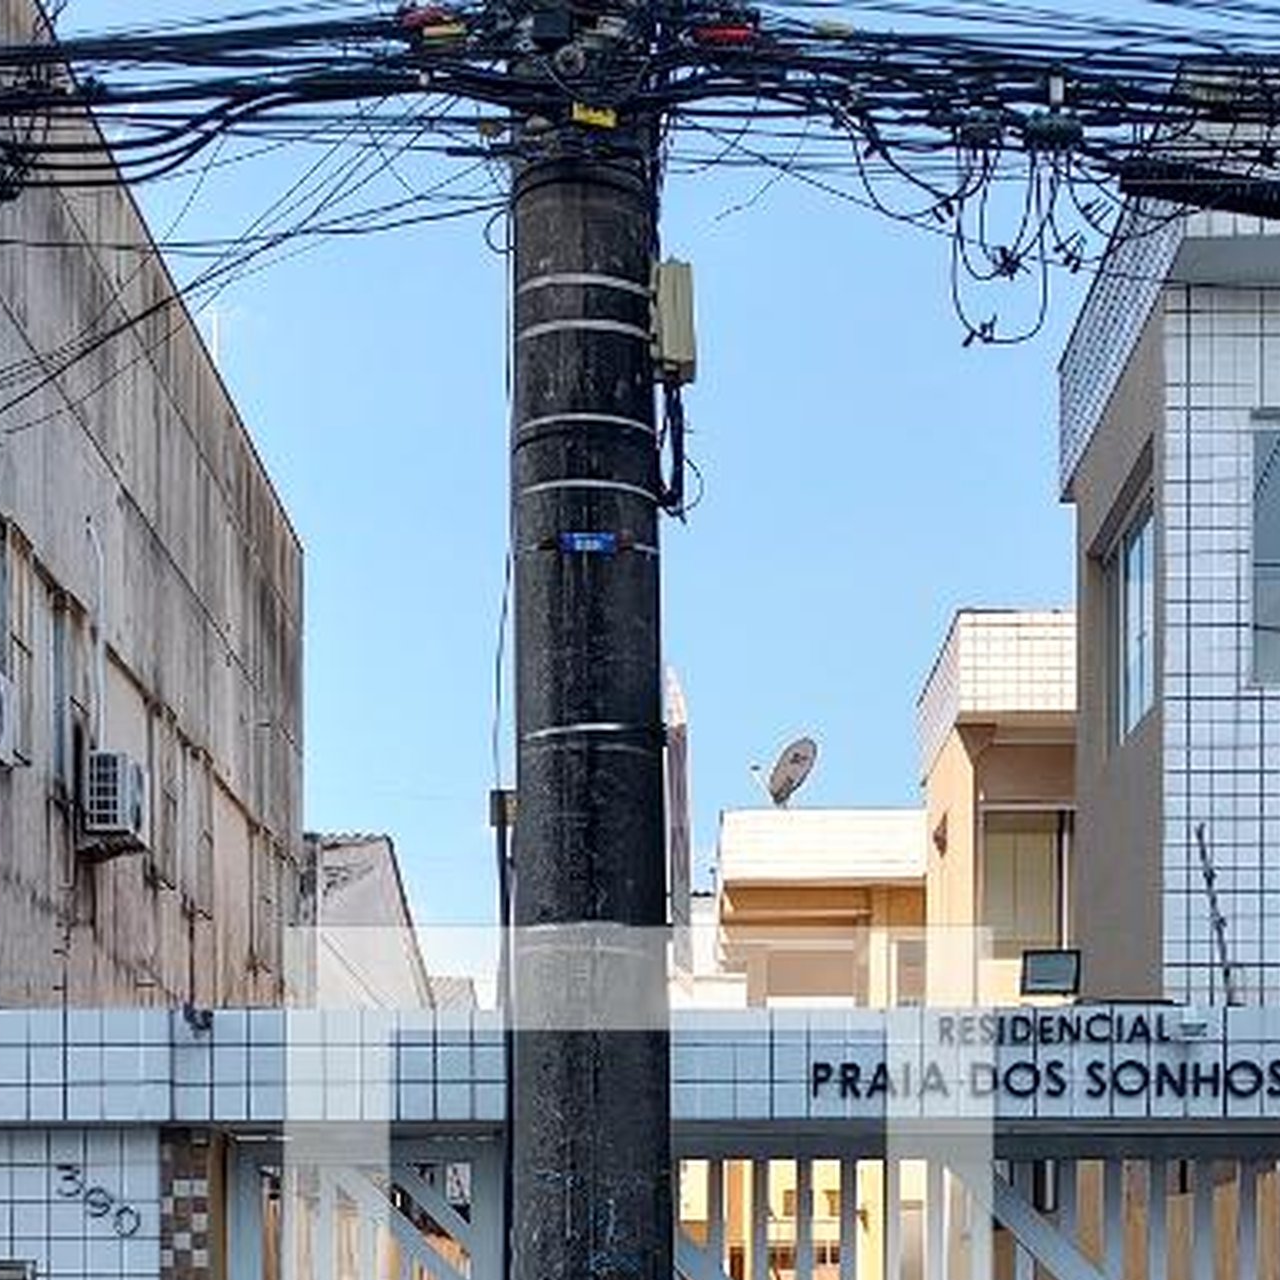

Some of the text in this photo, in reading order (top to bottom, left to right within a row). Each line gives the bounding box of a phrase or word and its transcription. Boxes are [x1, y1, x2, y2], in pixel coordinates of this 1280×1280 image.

[937, 1014, 1172, 1045] RESIDENCIAL
[810, 1061, 951, 1099] PRAIA
[970, 1060, 1068, 1099] DOS
